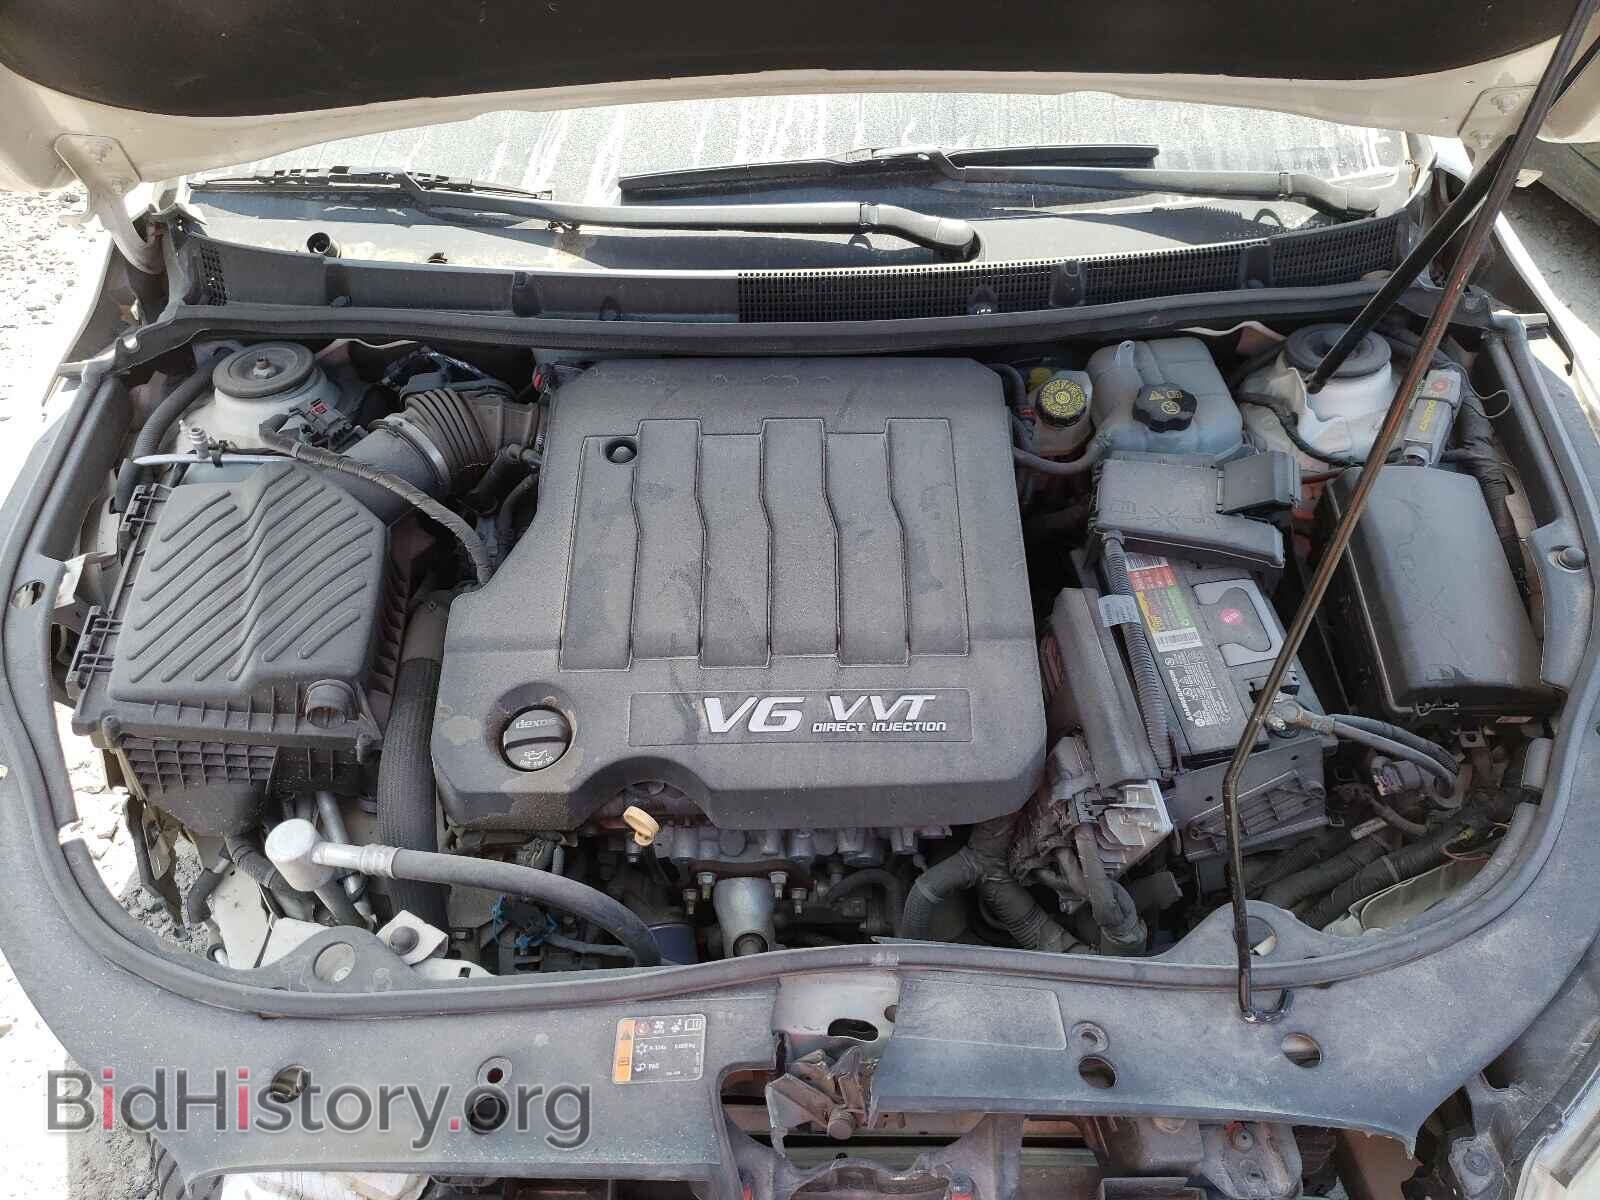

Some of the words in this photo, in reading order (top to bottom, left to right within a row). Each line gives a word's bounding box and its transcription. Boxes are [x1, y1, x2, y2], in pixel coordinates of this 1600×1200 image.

[704, 697, 805, 732] V6
[829, 695, 936, 720] VVT
[515, 718, 557, 728] dexos
[812, 721, 866, 733] DIRECT
[872, 721, 946, 732] INJECTION
